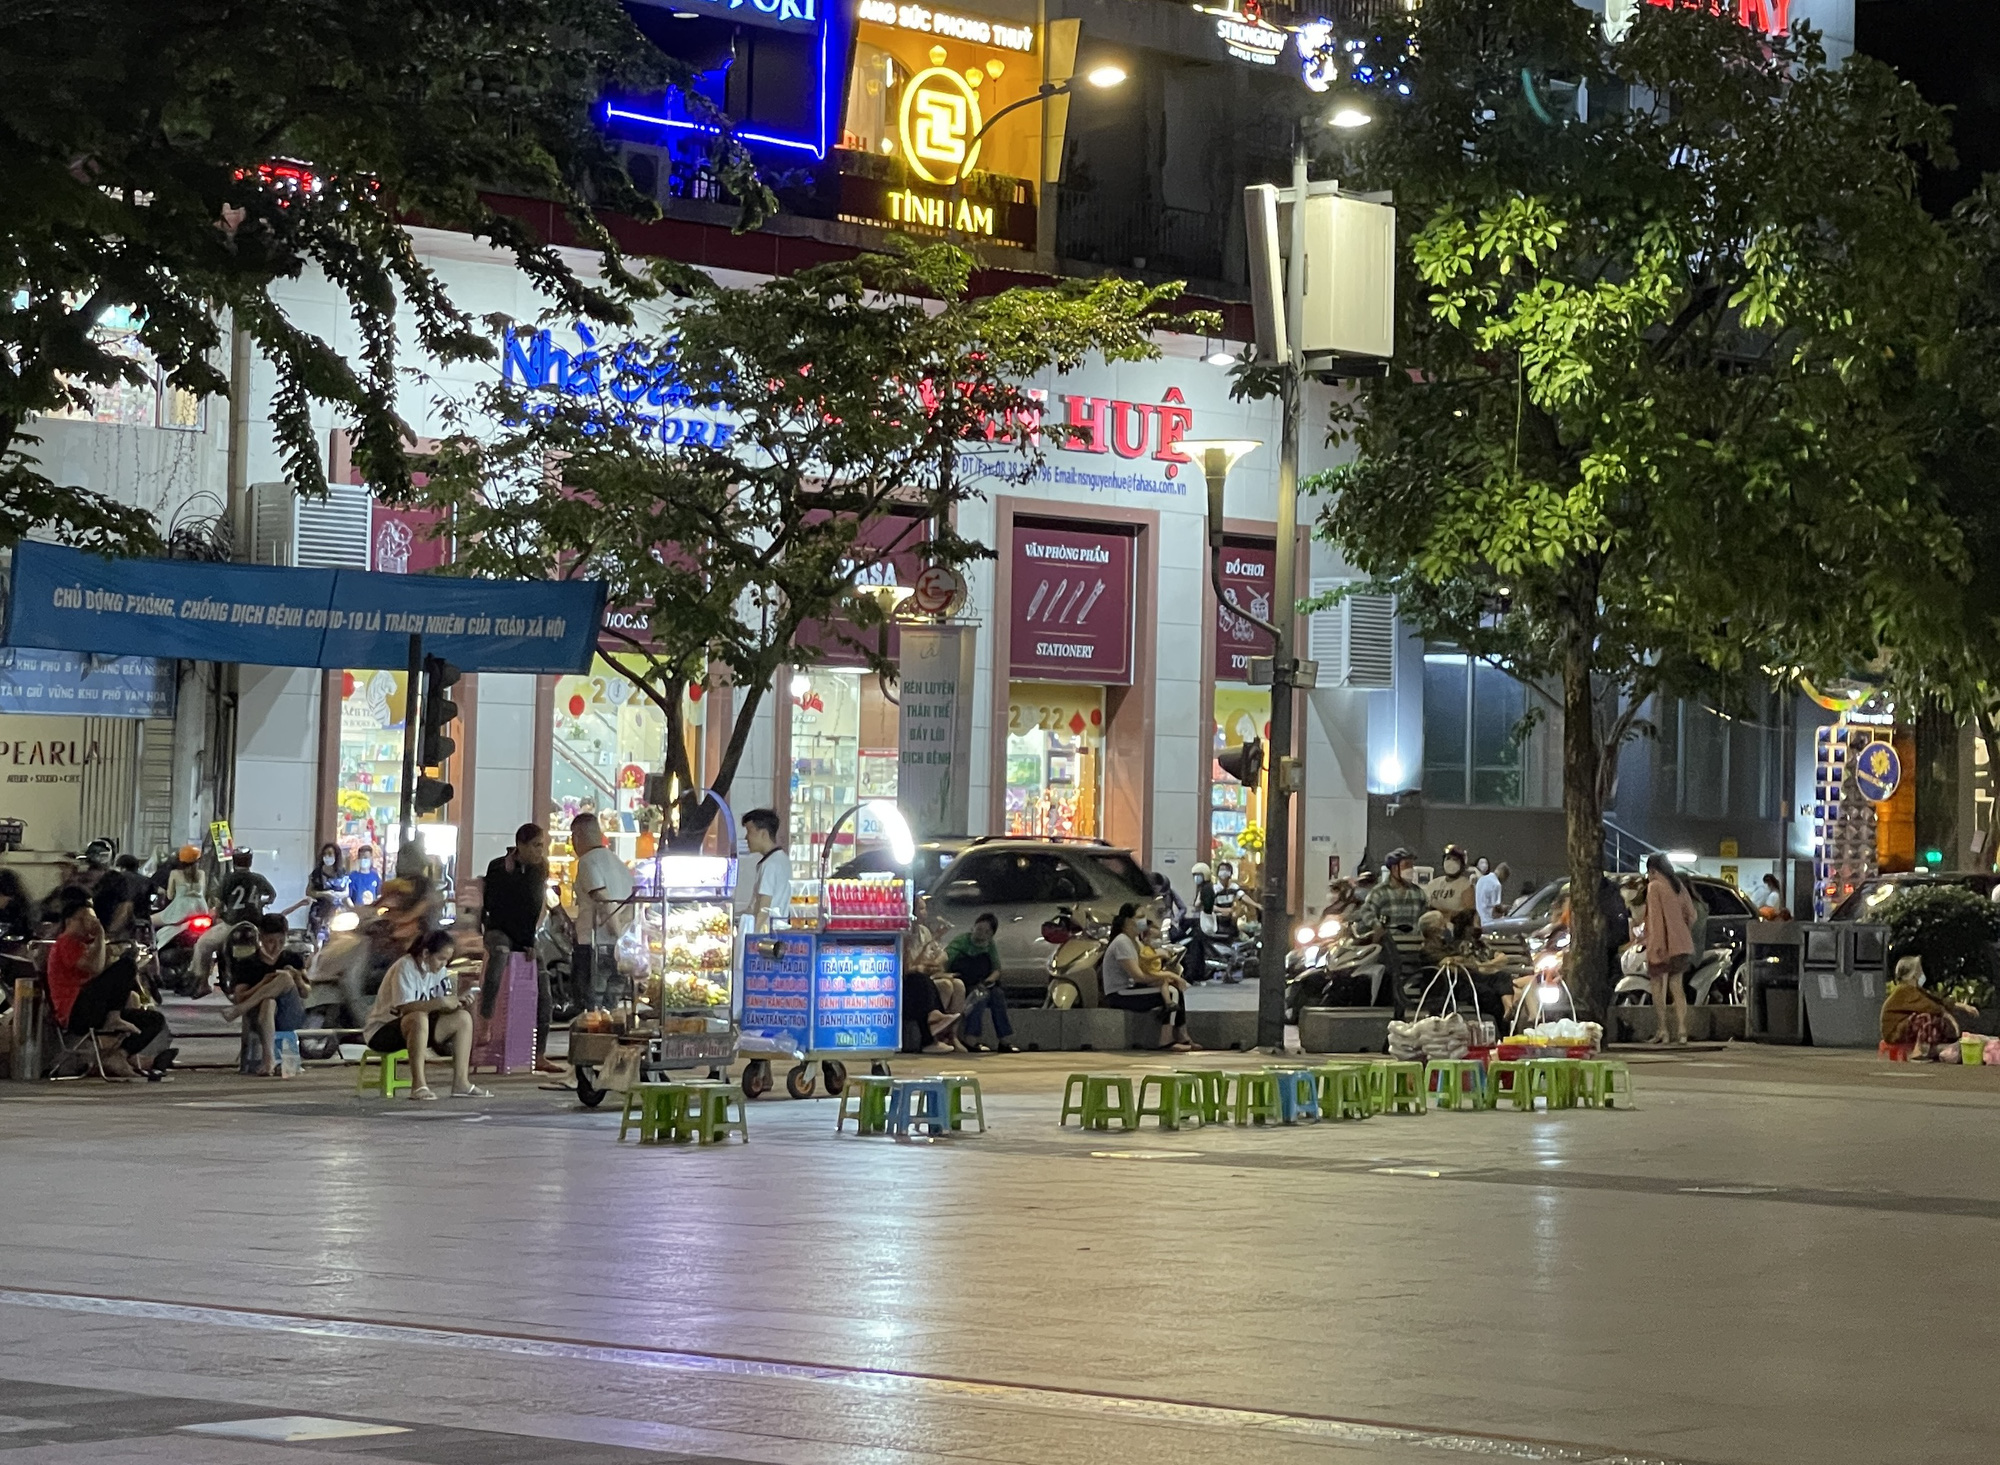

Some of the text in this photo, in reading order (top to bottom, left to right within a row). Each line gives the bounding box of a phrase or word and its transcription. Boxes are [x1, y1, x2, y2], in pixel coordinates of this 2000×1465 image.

[898, 4, 932, 32] SỨC
[934, 13, 991, 43] PHONG
[1217, 20, 1285, 51] STRONGBOW
[503, 321, 600, 397] Nhà
[1061, 387, 1193, 480] HUỆ
[1025, 542, 1109, 563] VĂN PHÒNG PHẨM
[1225, 558, 1265, 576] ĐỒ CHƠI
[53, 583, 566, 642] CHỦ ĐỘNG PHÒNG, CHỐNG DỊCH BỆNH COVID-19 LÀ TRÁCH NHIỆM CỦA TOÀN XÃ HỘI
[1036, 643, 1094, 658] STATIONERY
[17, 660, 37, 672] KHU
[78, 687, 98, 699] KHU
[103, 686, 121, 701] PHỐ
[0, 741, 101, 766] PEARLA
[231, 885, 259, 909] 24
[821, 957, 837, 973] TRÀ
[820, 1012, 842, 1026] BÁNH
[844, 1011, 871, 1026] TRÁNG
